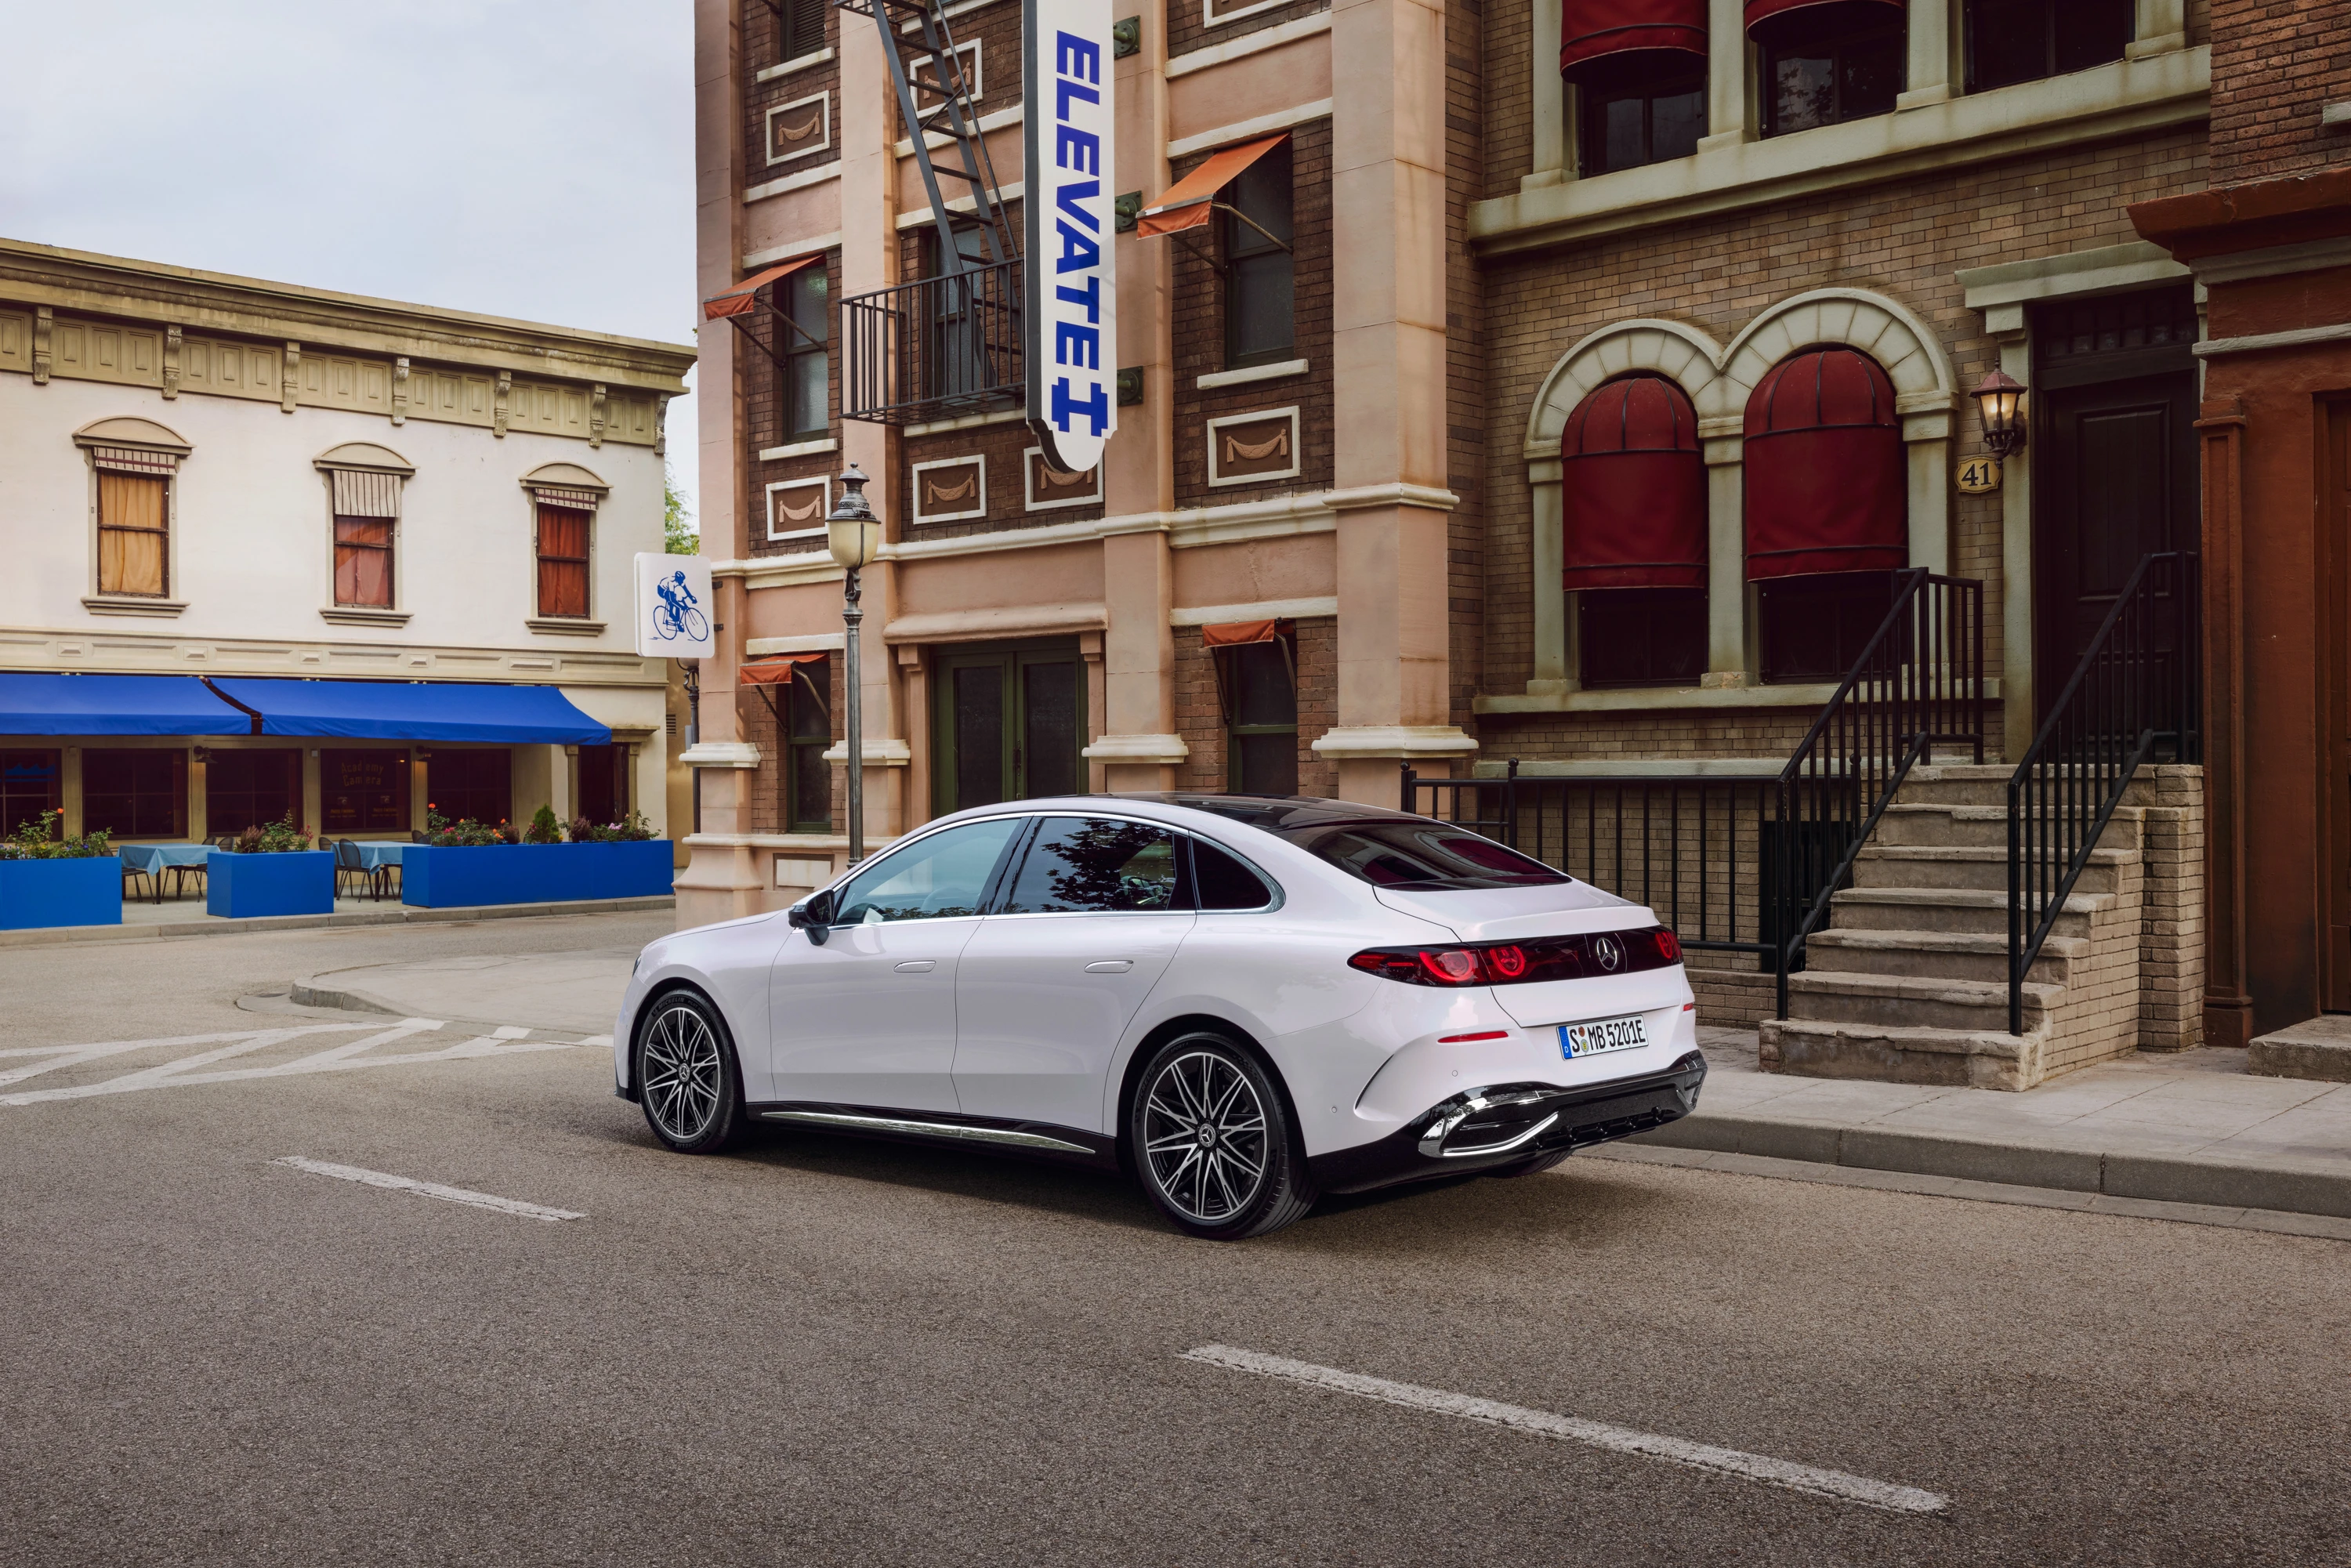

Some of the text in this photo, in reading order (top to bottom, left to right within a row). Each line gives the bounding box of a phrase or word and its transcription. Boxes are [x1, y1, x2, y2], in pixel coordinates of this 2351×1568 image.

[1056, 29, 1100, 371] ELEVATE
[1961, 462, 1992, 487] 41
[341, 760, 384, 775] Academy
[342, 774, 382, 787] Camera
[657, 996, 686, 1010] MICHELIN
[1569, 1019, 1646, 1053] S MB 5201E
[1136, 1064, 1156, 1110] MICHELIN
[1170, 1042, 1185, 1053] SPORT
[674, 1136, 704, 1150] MICHELIN
